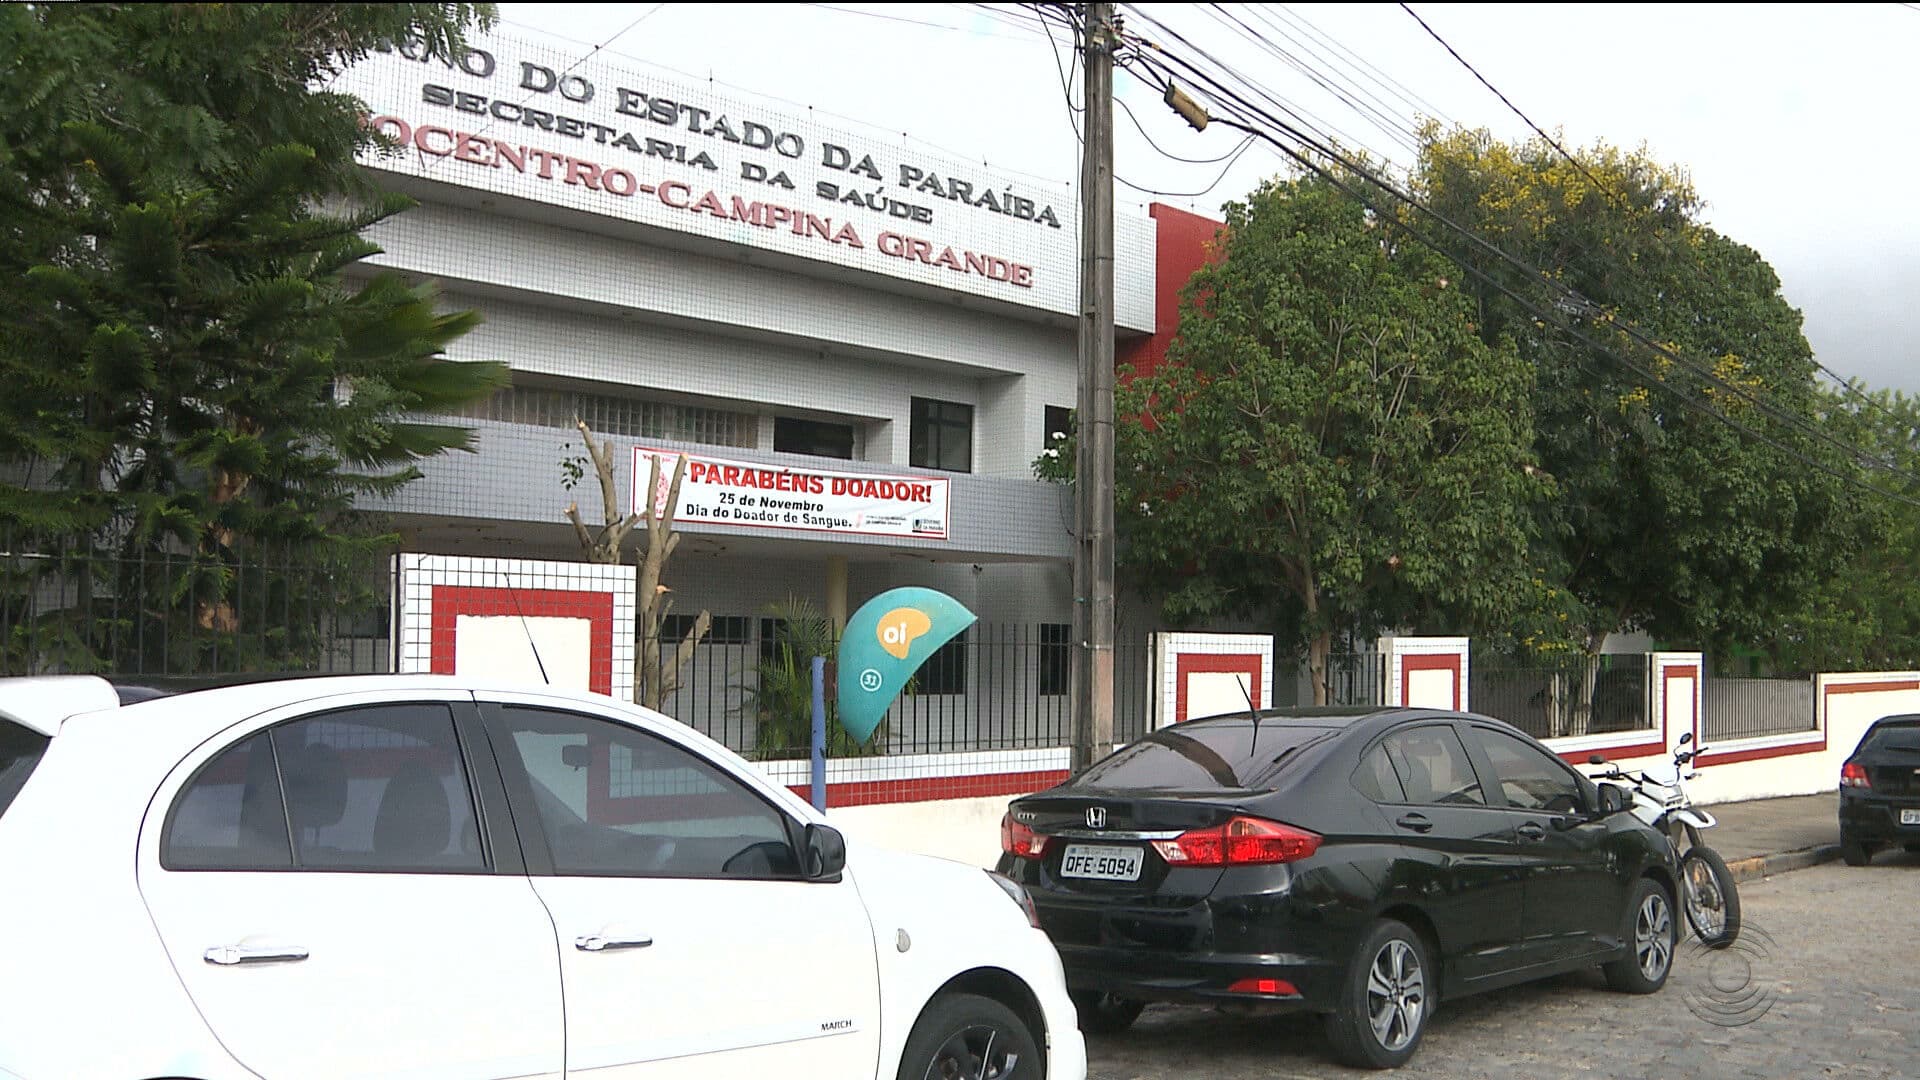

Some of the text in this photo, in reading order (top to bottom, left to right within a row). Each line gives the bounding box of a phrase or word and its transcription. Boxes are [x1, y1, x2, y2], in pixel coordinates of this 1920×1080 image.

[422, 82, 933, 224] SECRETARIA DA SAÚDE
[519, 61, 594, 103] DO
[615, 87, 804, 159] ESTADO
[822, 142, 882, 180] DA
[899, 164, 1061, 228] PARAÍBA
[877, 230, 1034, 288] GRANDE
[690, 462, 932, 503] PARABÉNS DOADOR!
[719, 492, 824, 512] 25 de Novembro
[686, 503, 852, 528] Dia do Doador de Sangue.
[883, 621, 907, 645] oi
[863, 674, 877, 687] 31
[1017, 811, 1037, 820] CITY
[1097, 857, 1135, 876] 5094
[821, 1019, 852, 1031] MARCH
